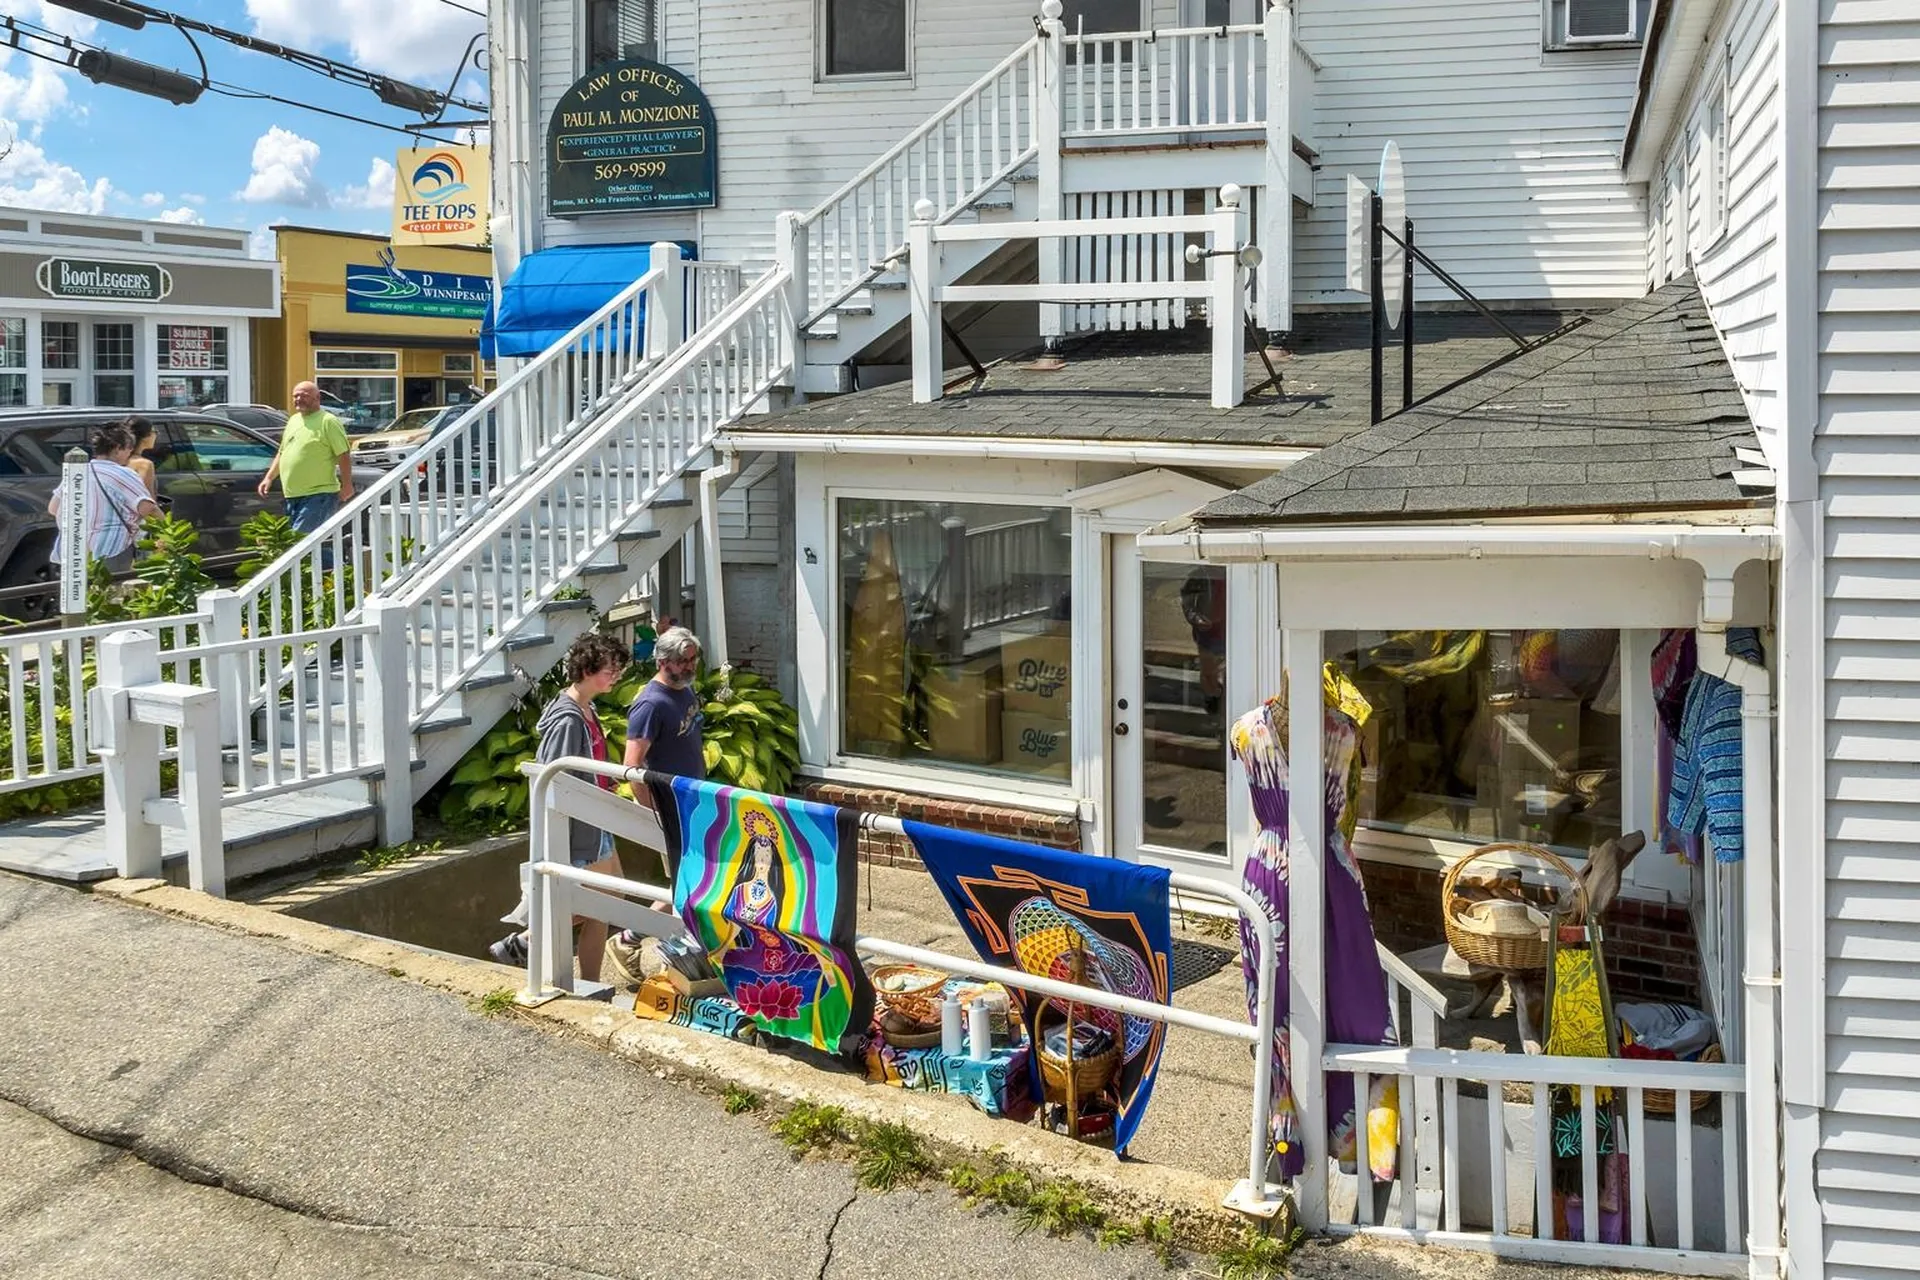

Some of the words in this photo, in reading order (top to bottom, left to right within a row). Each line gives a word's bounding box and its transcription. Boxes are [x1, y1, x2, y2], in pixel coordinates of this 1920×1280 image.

[577, 73, 610, 101] LAW
[618, 68, 684, 96] OFFICES
[620, 90, 639, 102] OF
[563, 112, 595, 128] PAUL
[599, 111, 616, 125] M.
[619, 104, 700, 124] MONZIONE
[563, 135, 622, 146] EXPERIENCED
[625, 134, 653, 142] TRIAL
[656, 130, 698, 140] LAWYERS
[587, 149, 628, 157] GENERAL
[630, 146, 673, 155] PRACTICE
[594, 161, 666, 180] 569-9599
[403, 205, 430, 220] TEE
[435, 203, 476, 219] TOPS
[409, 222, 441, 231] resort
[444, 222, 470, 231] wear
[62, 286, 112, 296] FOOTWEAR
[116, 288, 153, 297] CENTER
[173, 329, 208, 339] SUMMER
[172, 352, 208, 367] SALE
[73, 473, 83, 490] Que
[1015, 658, 1067, 692] Blue
[1019, 728, 1058, 752] Blue
